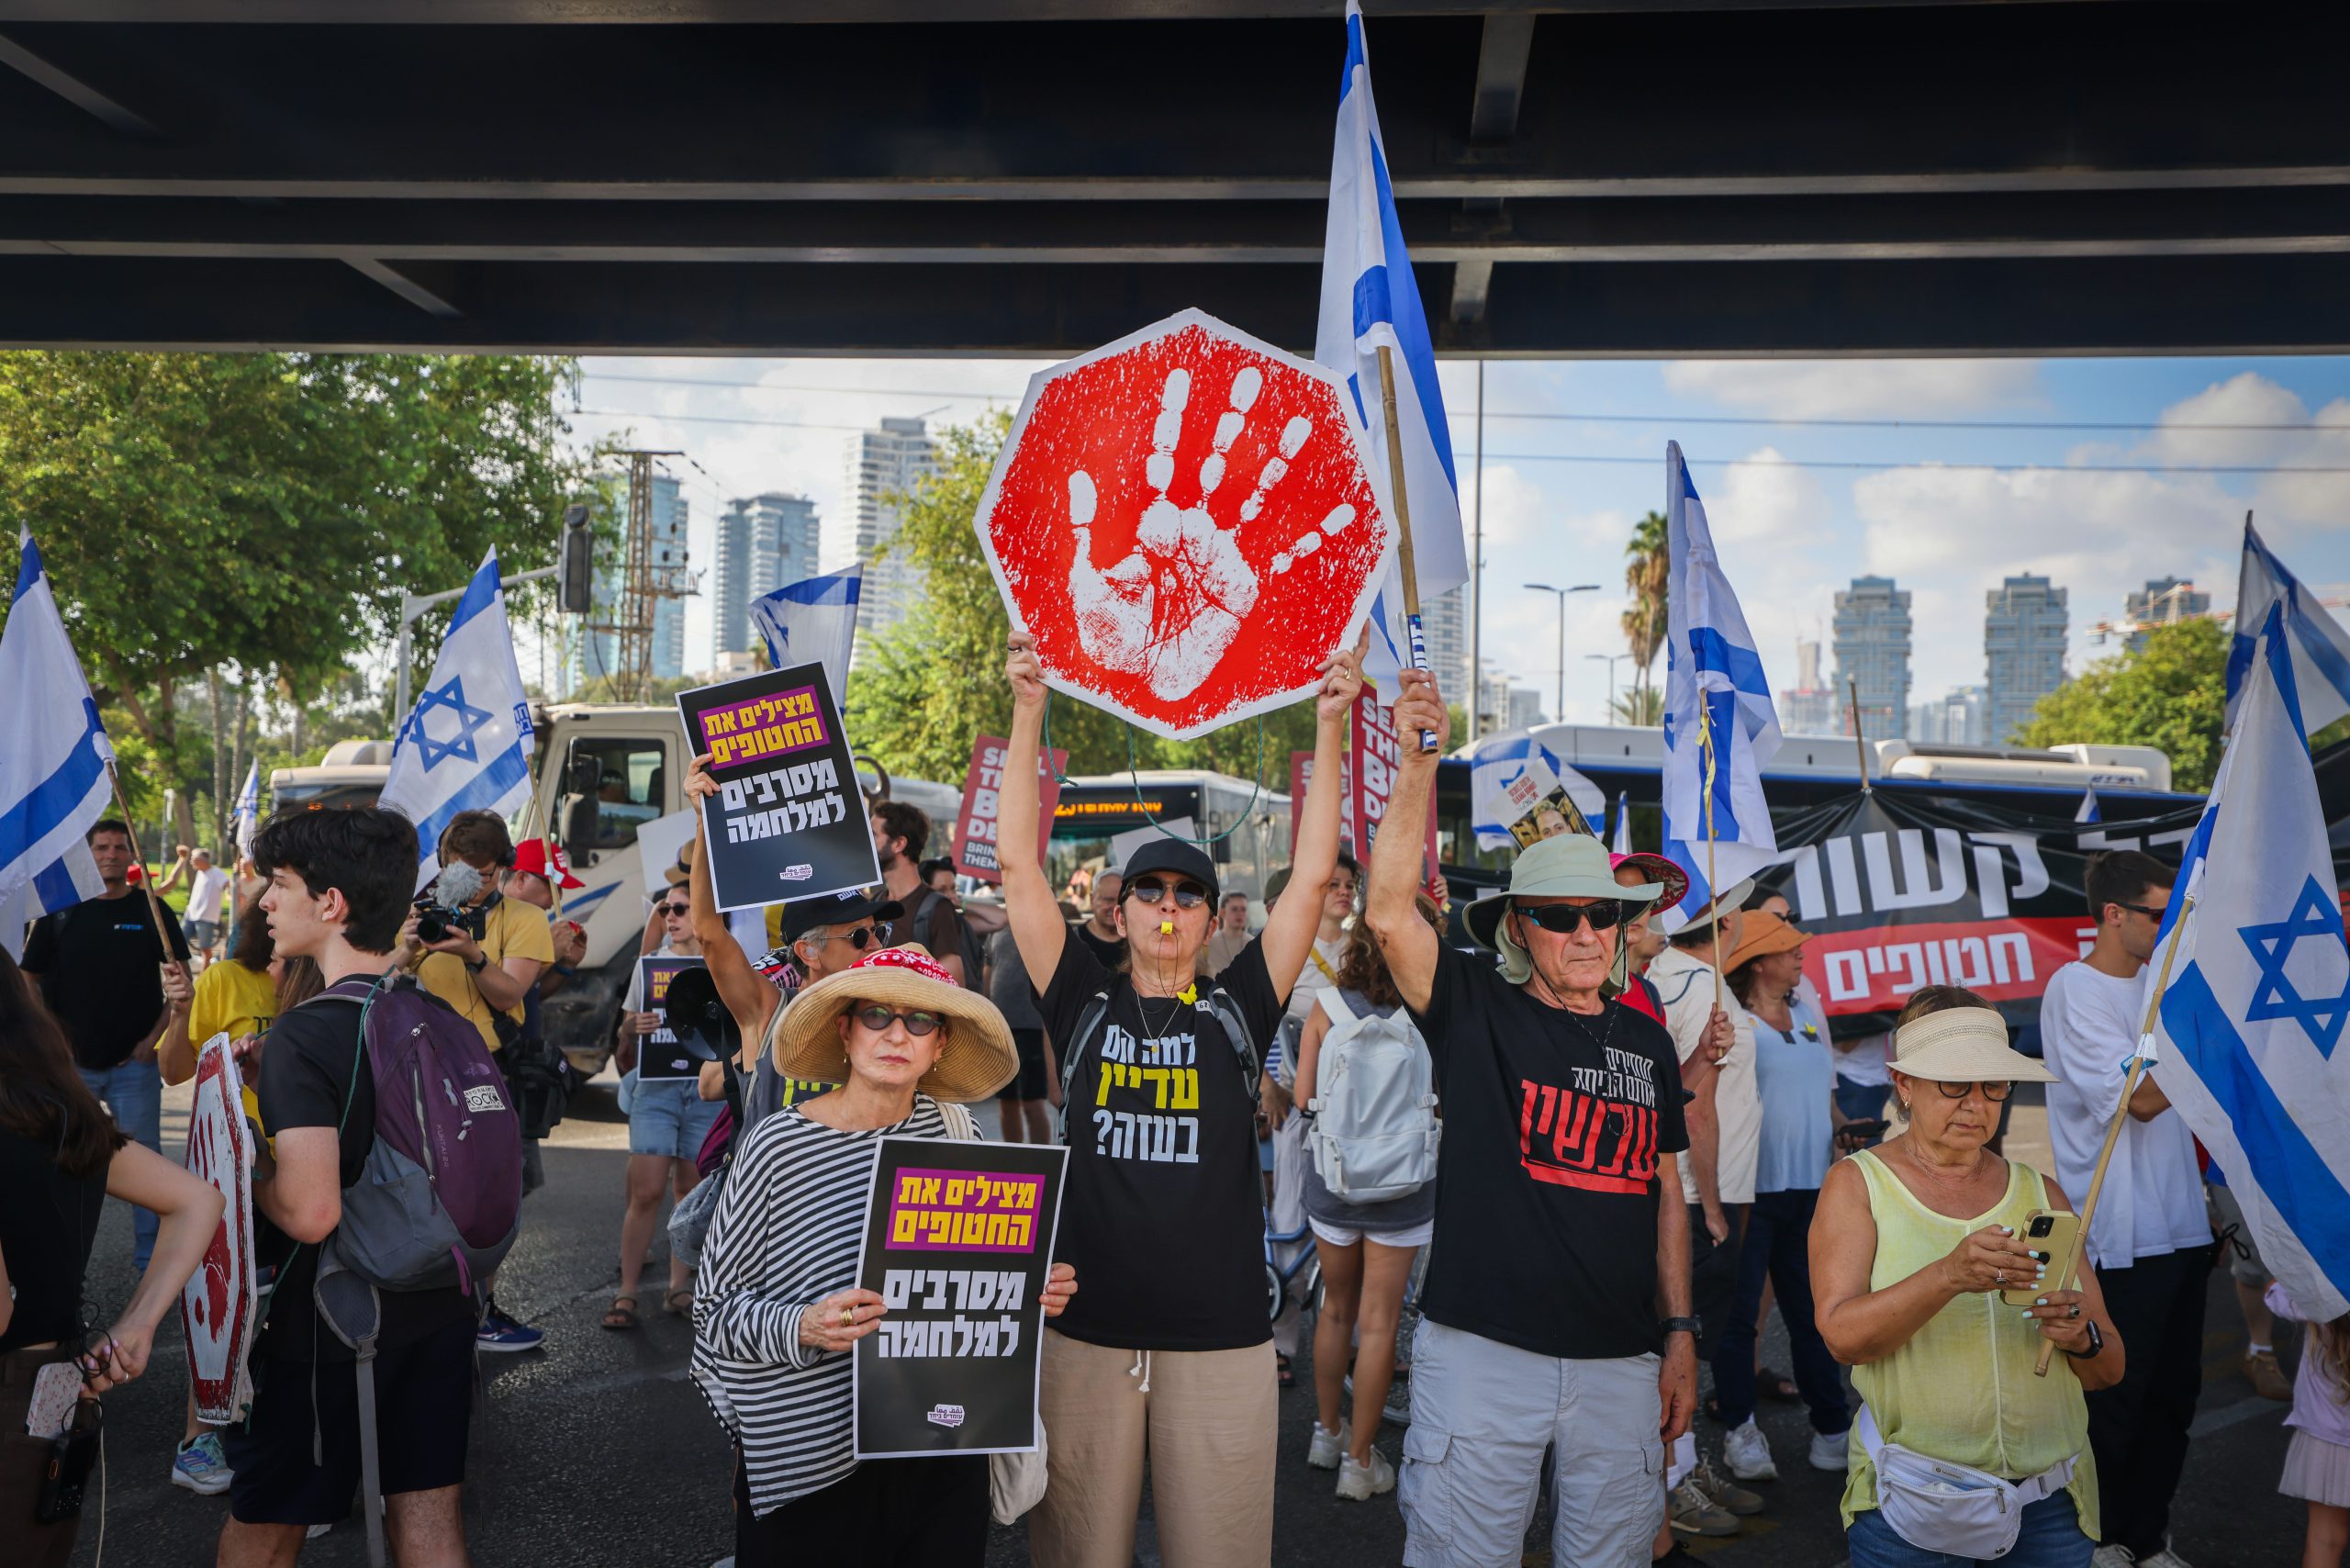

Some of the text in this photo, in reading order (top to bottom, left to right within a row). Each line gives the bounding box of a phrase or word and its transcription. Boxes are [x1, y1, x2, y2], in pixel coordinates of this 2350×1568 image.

[703, 692, 815, 736] מצילים את
[710, 716, 823, 765] החטופים
[721, 757, 840, 812] מסרבים
[726, 791, 846, 844] למלחמה
[653, 971, 671, 983] את
[1823, 932, 2035, 1002] חטופים
[1102, 1025, 1196, 1066] למה הם
[1095, 1061, 1200, 1110] עדיין
[1092, 1109, 1199, 1163] בעזה?
[1520, 1079, 1658, 1182] עכשיו
[898, 1175, 1037, 1210] מצילים את
[892, 1210, 1032, 1247] החטופים
[883, 1269, 1027, 1311] מסרבים
[878, 1315, 1021, 1359] למלחמה
